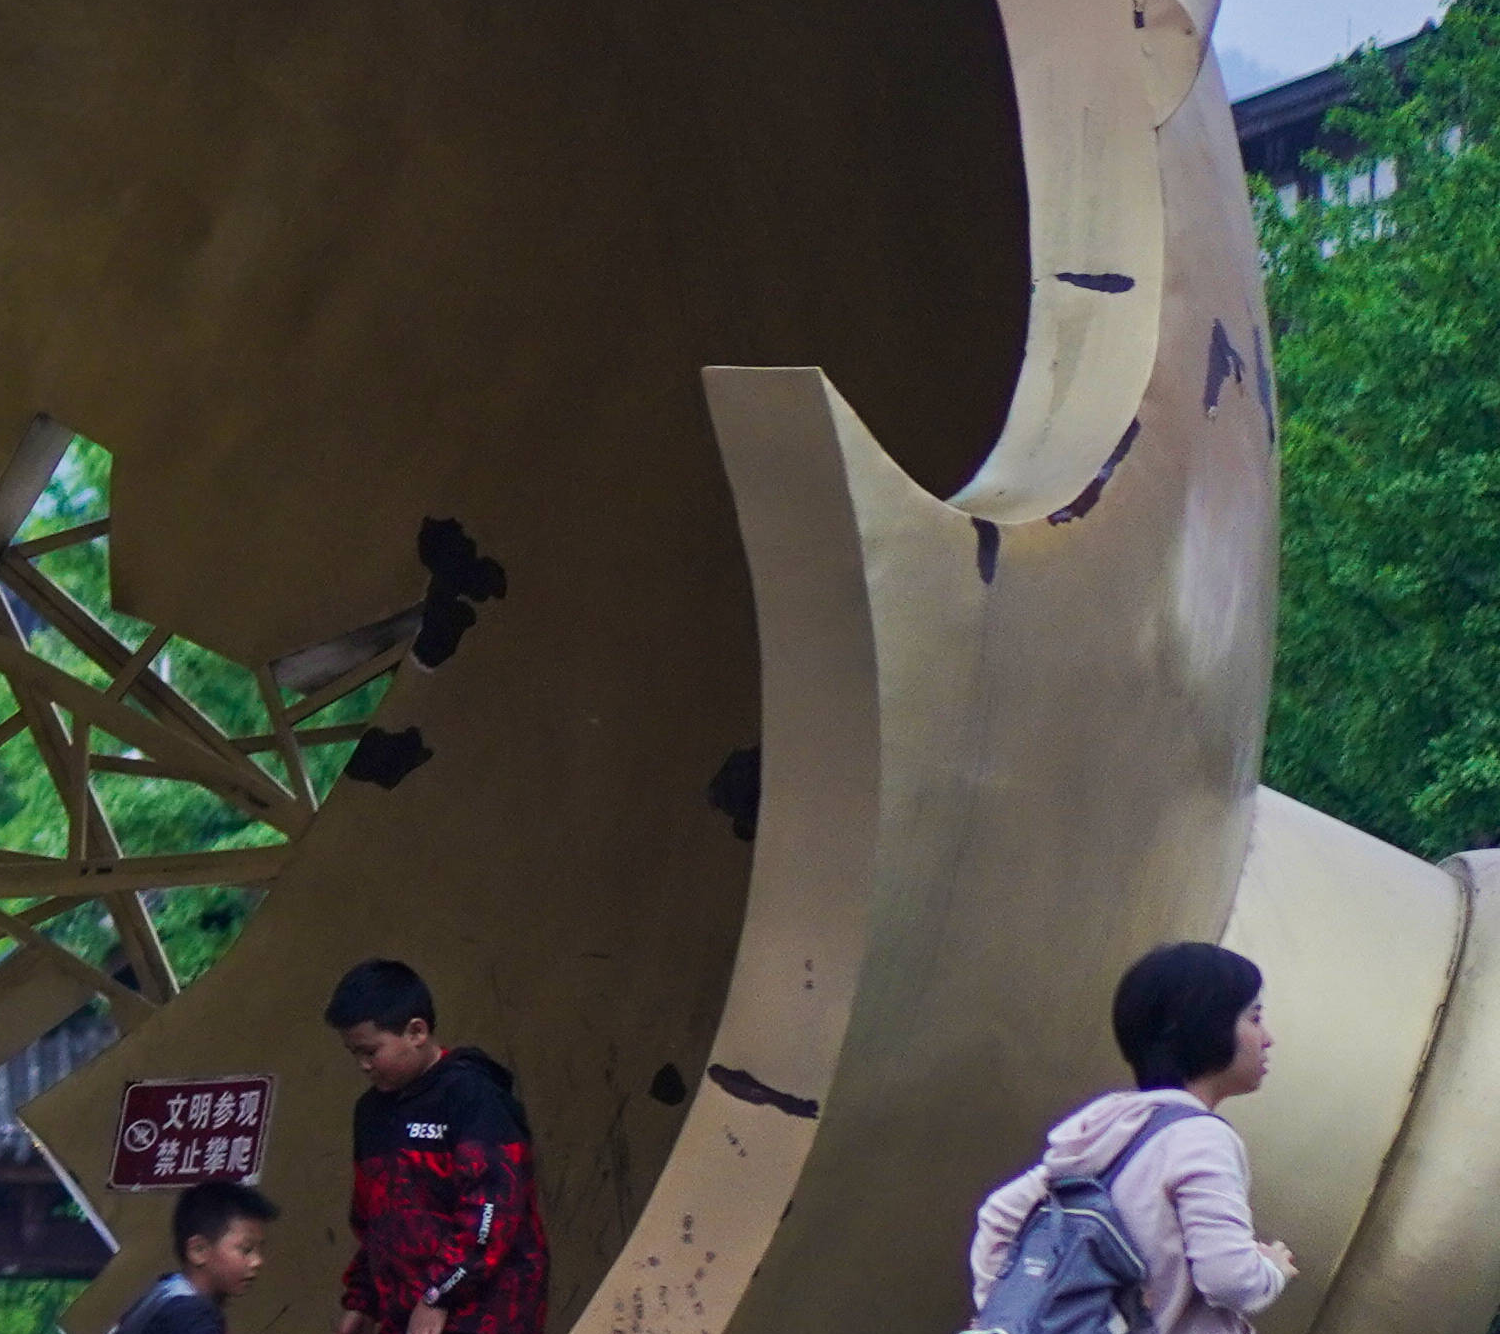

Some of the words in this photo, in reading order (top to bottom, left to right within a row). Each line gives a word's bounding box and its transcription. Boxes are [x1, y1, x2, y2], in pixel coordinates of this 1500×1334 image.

[162, 1089, 263, 1132] 文明参观
[153, 1134, 254, 1177] 禁止攀爬
